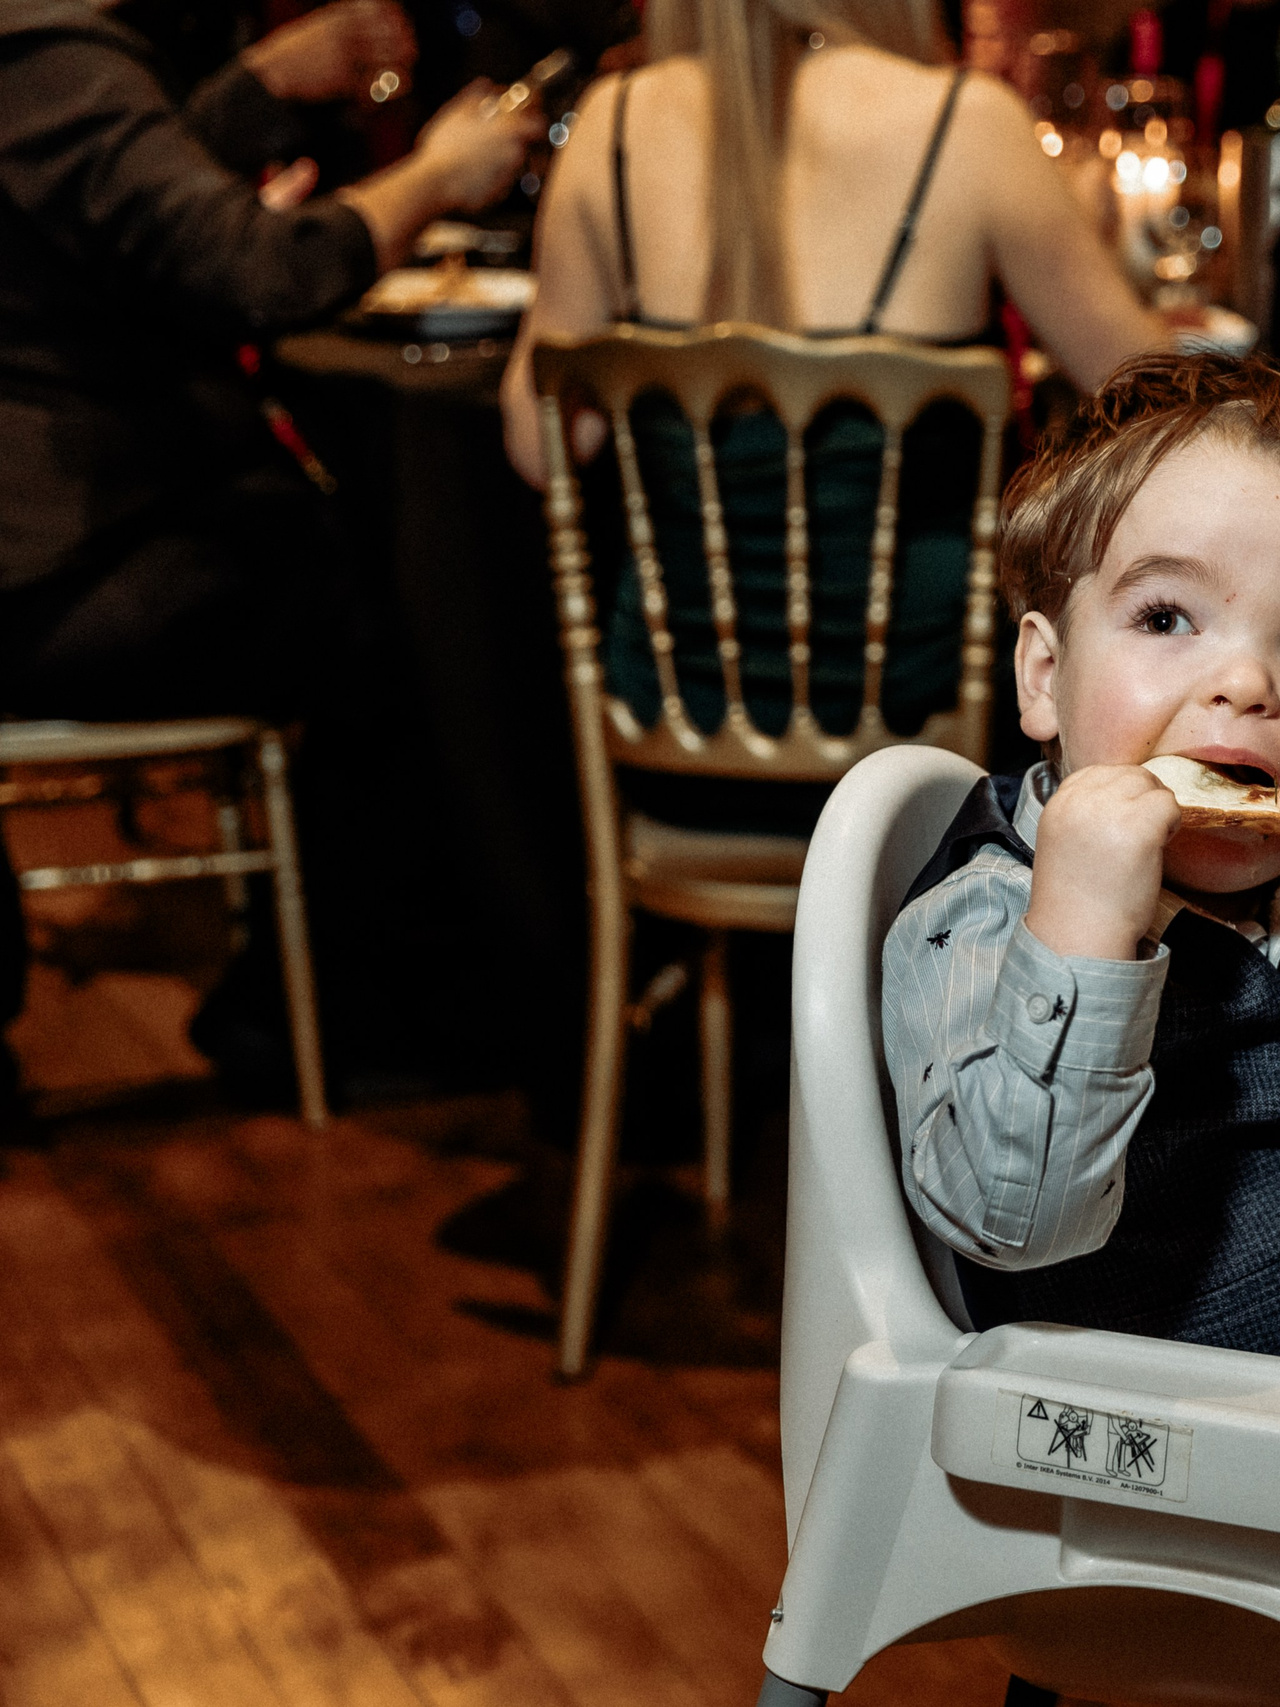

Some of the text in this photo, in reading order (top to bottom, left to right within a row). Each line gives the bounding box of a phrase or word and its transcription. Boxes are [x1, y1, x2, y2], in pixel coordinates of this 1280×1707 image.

[1040, 1466, 1054, 1474] IKEA
[1056, 1470, 1080, 1479] Systems
[1095, 1477, 1110, 1485] 2014
